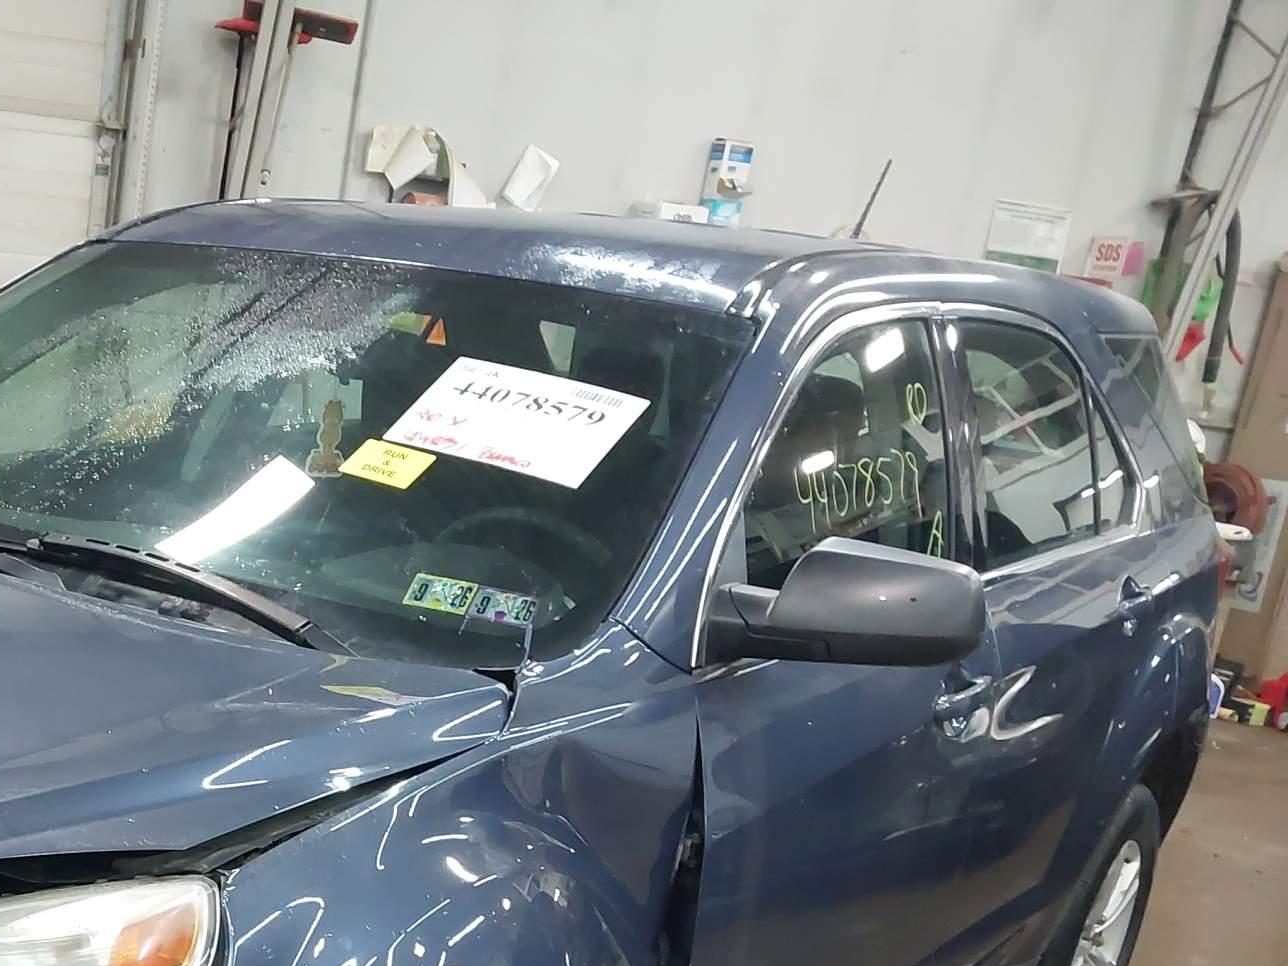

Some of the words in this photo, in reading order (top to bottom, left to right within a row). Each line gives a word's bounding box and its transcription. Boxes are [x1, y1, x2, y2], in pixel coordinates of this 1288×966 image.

[1095, 243, 1123, 263] SDS
[452, 381, 607, 426] 44078579
[383, 449, 409, 461] RUN
[361, 463, 398, 479] DRIVE
[793, 447, 923, 535] 44078579
[413, 583, 430, 602] 9
[476, 595, 492, 615] 9
[513, 598, 537, 623] 26
